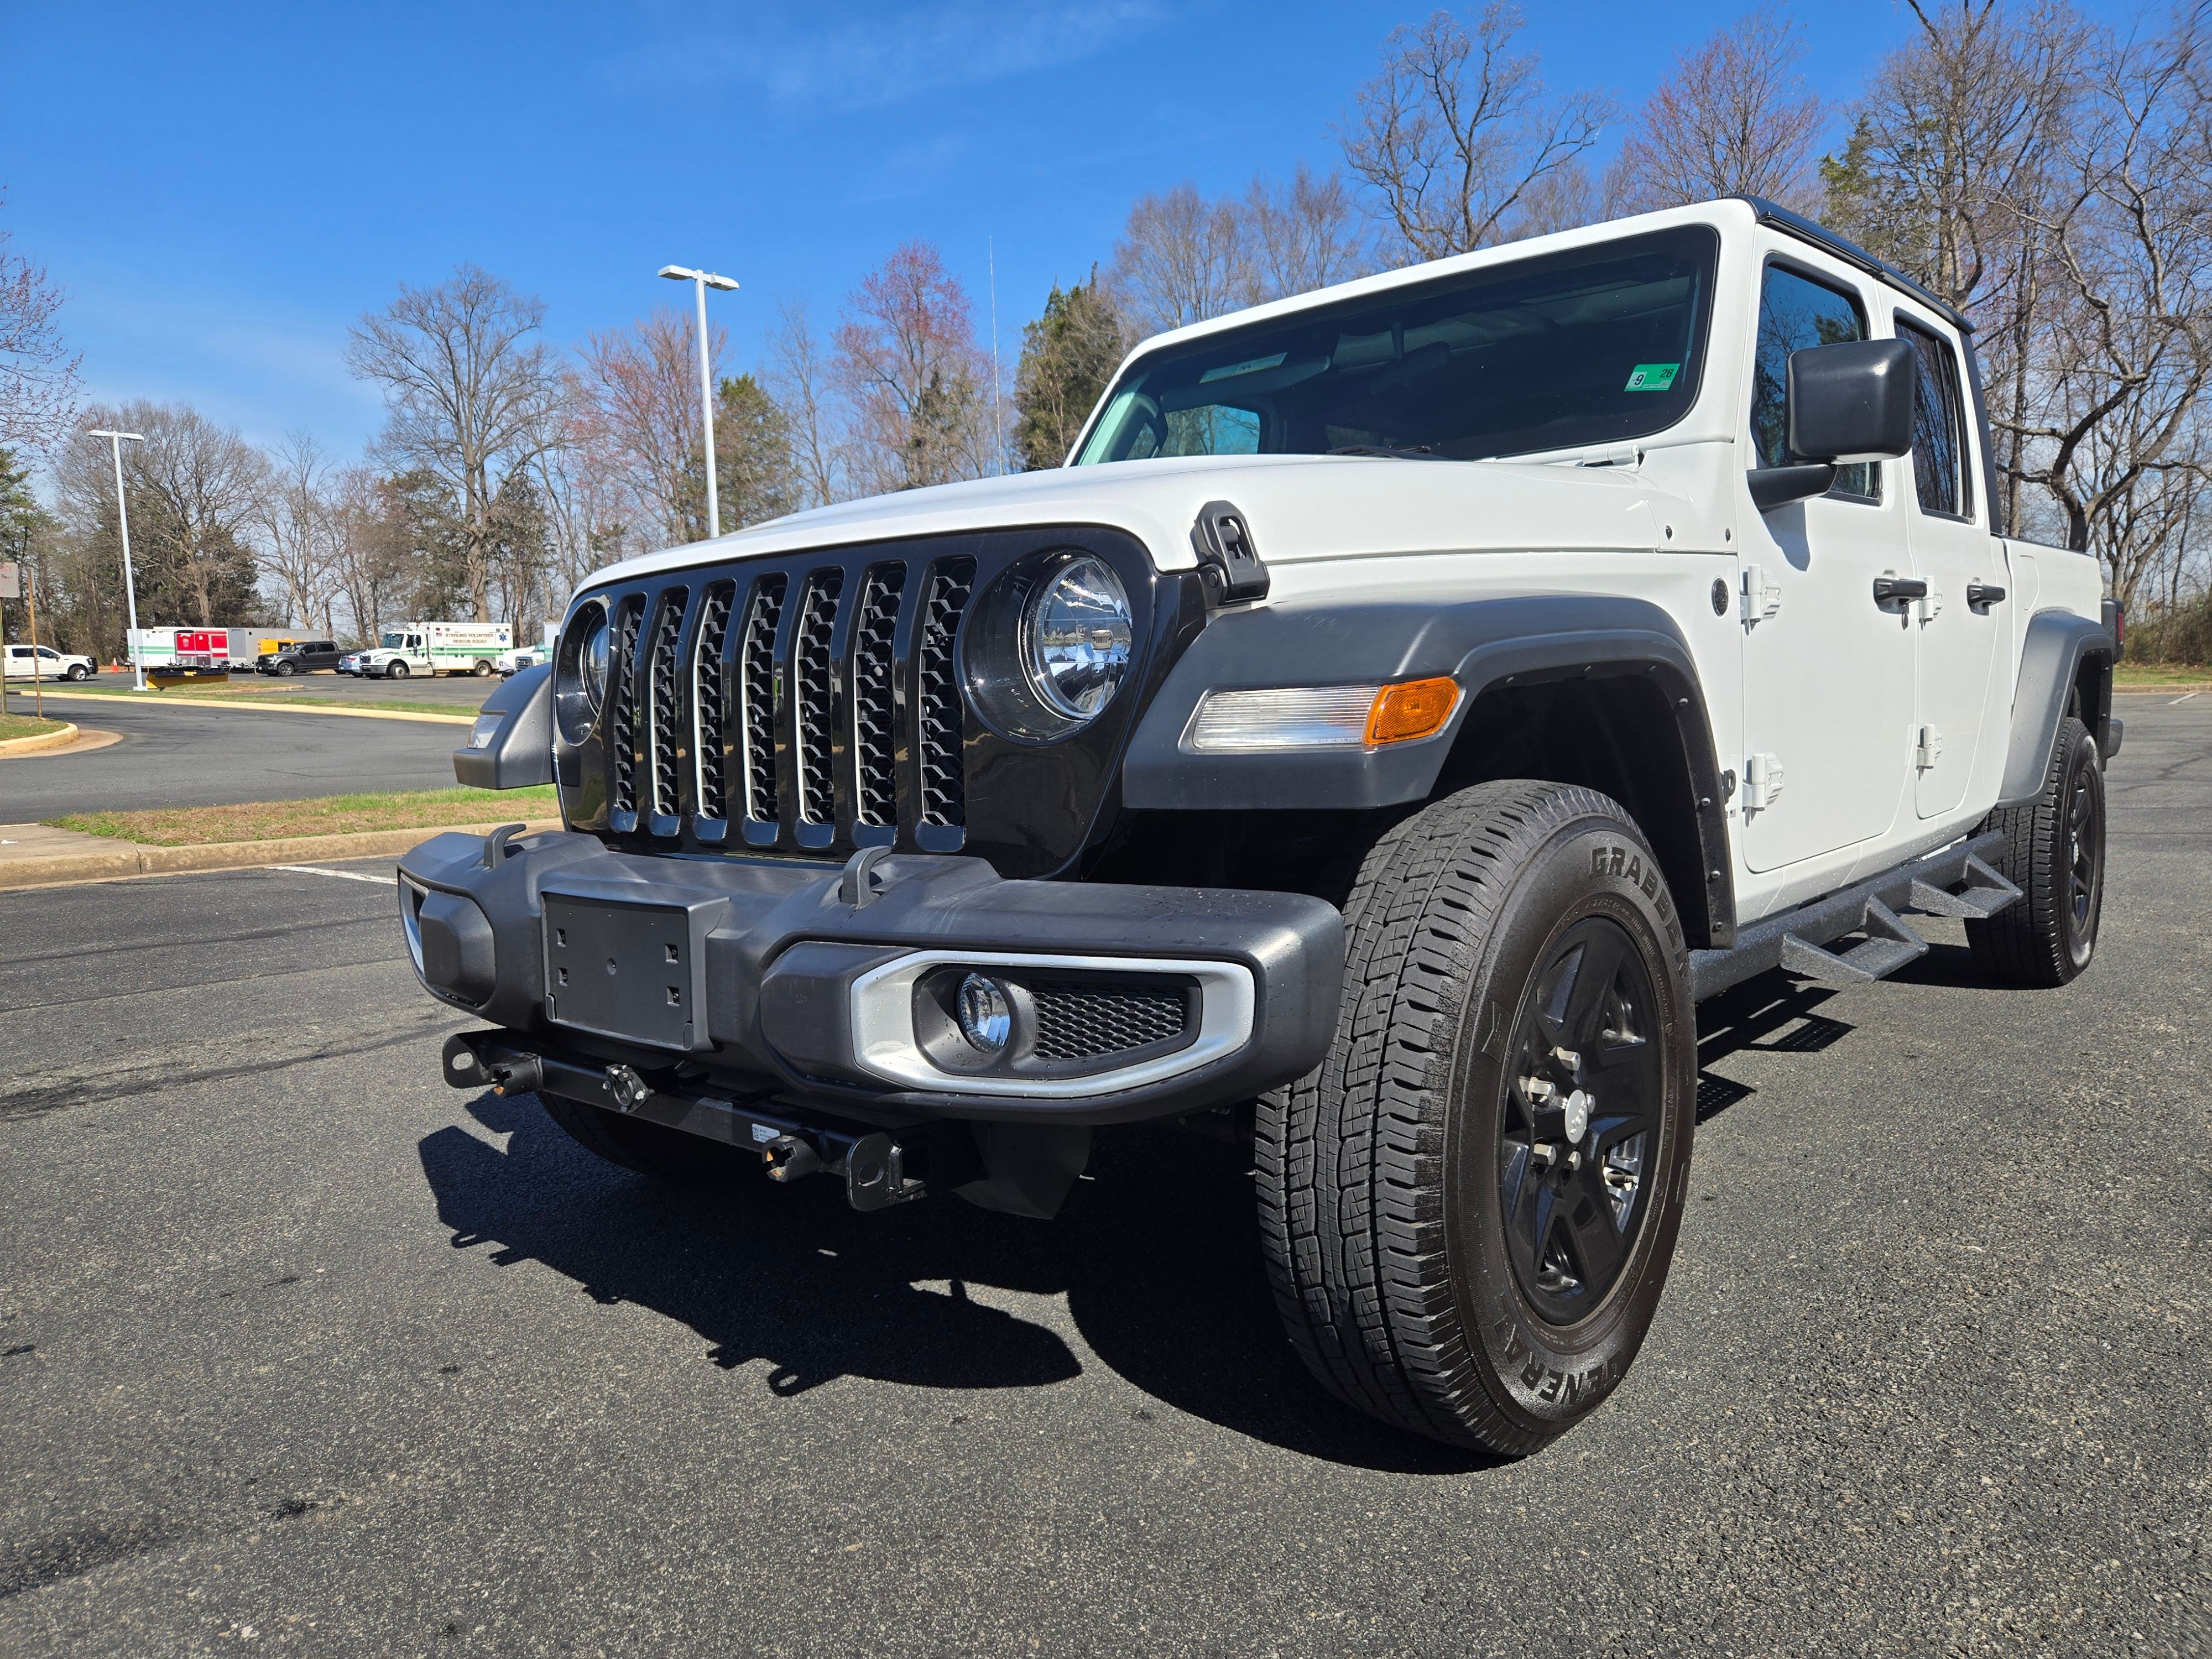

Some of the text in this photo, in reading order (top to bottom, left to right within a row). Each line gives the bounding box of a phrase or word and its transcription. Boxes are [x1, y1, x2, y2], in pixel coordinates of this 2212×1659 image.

[1659, 368, 1674, 378] 26
[1634, 374, 1645, 385] 9
[1589, 846, 1688, 980] GRABBER
